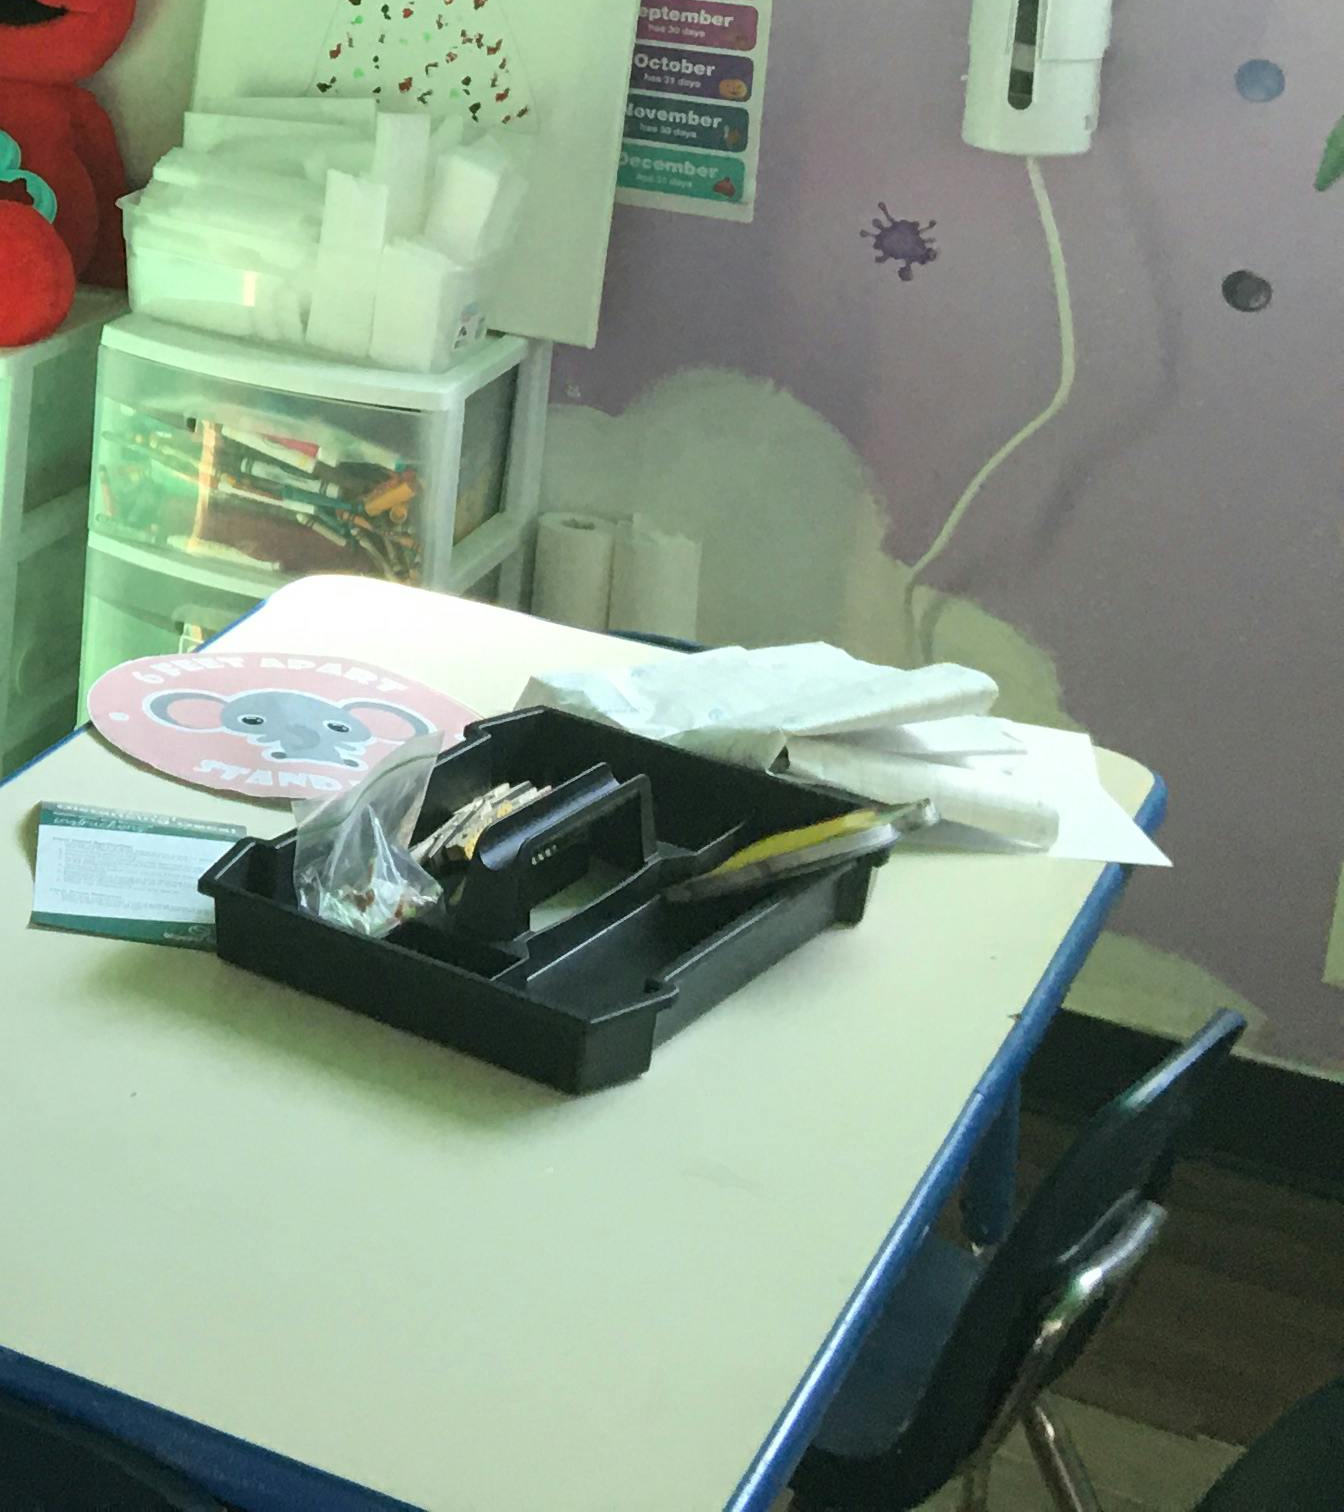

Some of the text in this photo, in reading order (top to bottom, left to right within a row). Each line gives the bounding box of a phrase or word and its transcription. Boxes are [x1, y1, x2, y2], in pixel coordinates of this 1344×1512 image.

[639, 6, 734, 27] eptember
[634, 53, 715, 76] October
[625, 103, 722, 128] ovember
